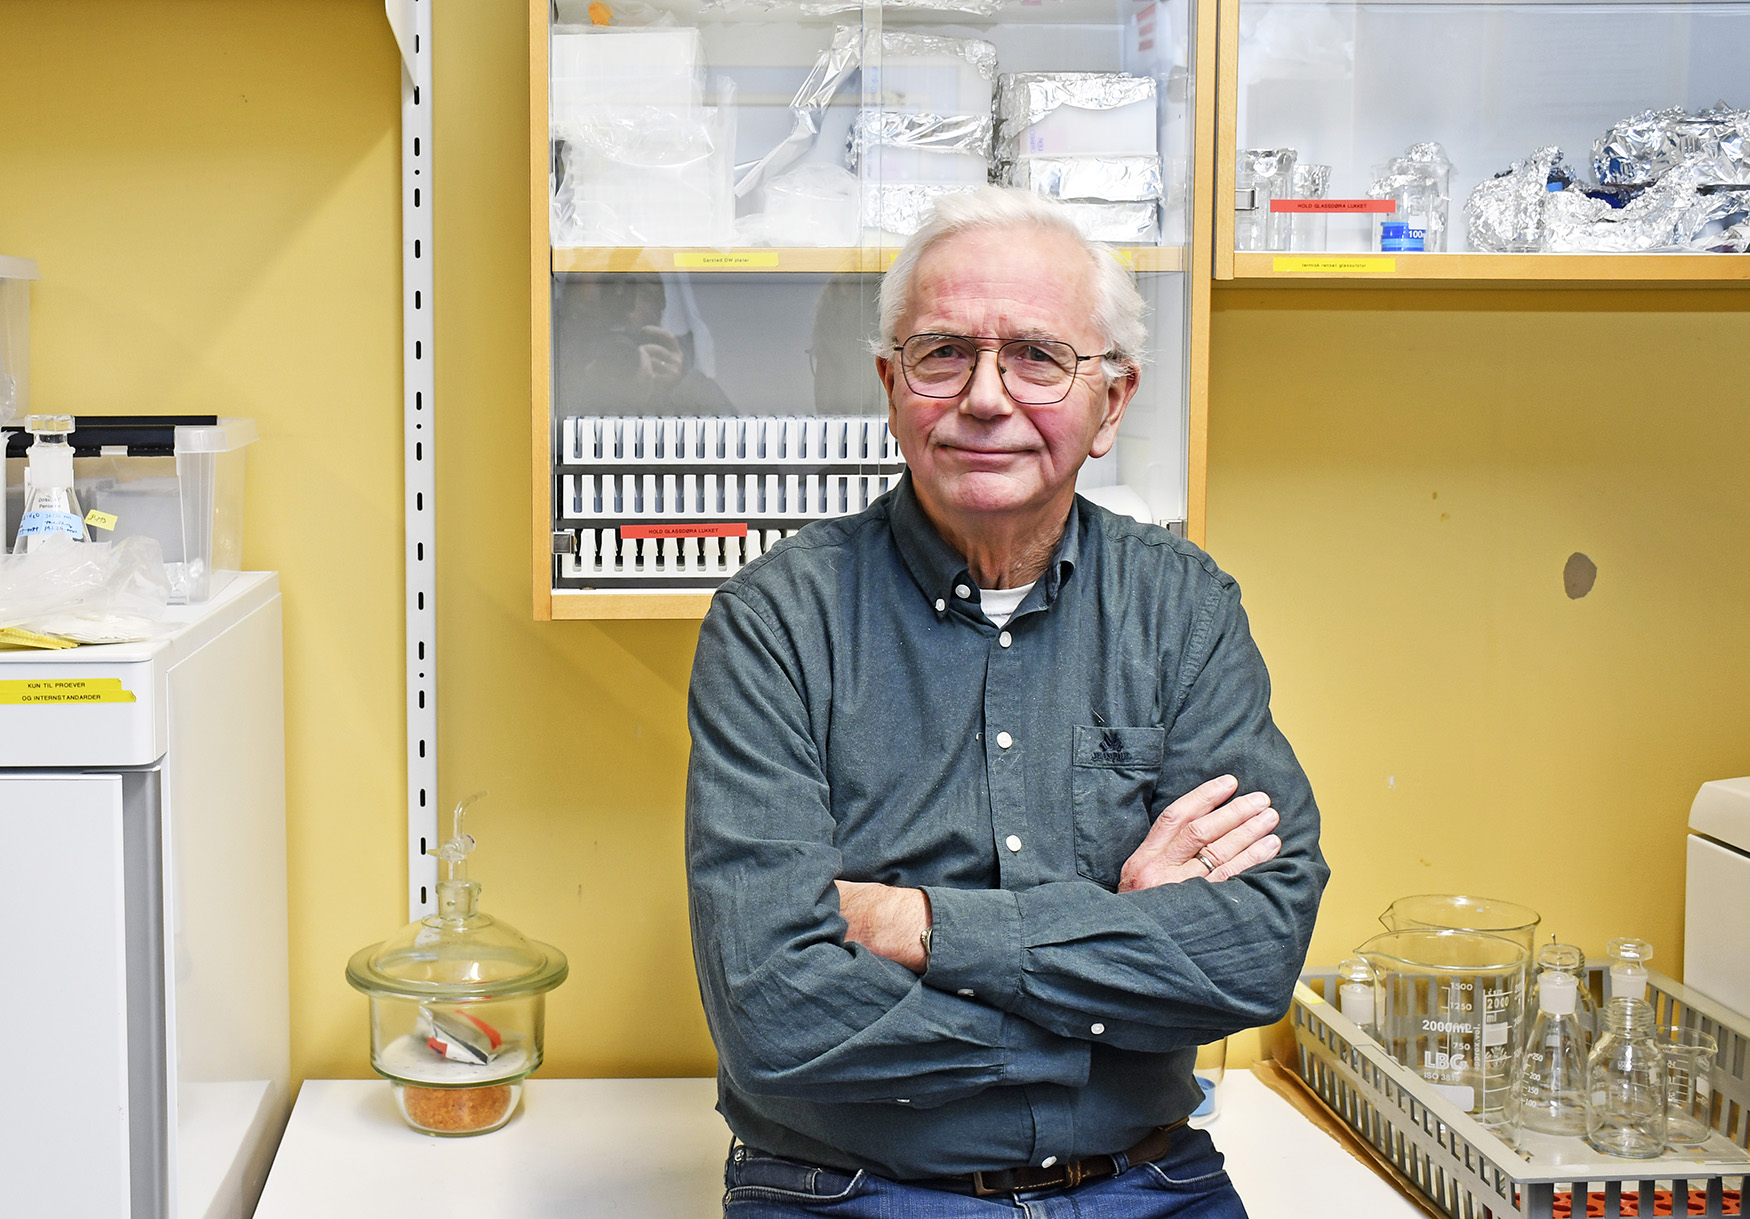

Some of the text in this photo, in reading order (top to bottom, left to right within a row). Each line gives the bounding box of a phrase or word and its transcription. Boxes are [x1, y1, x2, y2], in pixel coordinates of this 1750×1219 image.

[1450, 982, 1473, 991] 1500
[1450, 1002, 1472, 1011] 1250
[1453, 1042, 1471, 1051] 750
[1424, 1051, 1468, 1072] LBG
[1532, 1052, 1544, 1062] 250
[1423, 1072, 1439, 1080] ISO
[1529, 1072, 1541, 1081] 200
[1527, 1085, 1539, 1095] 150
